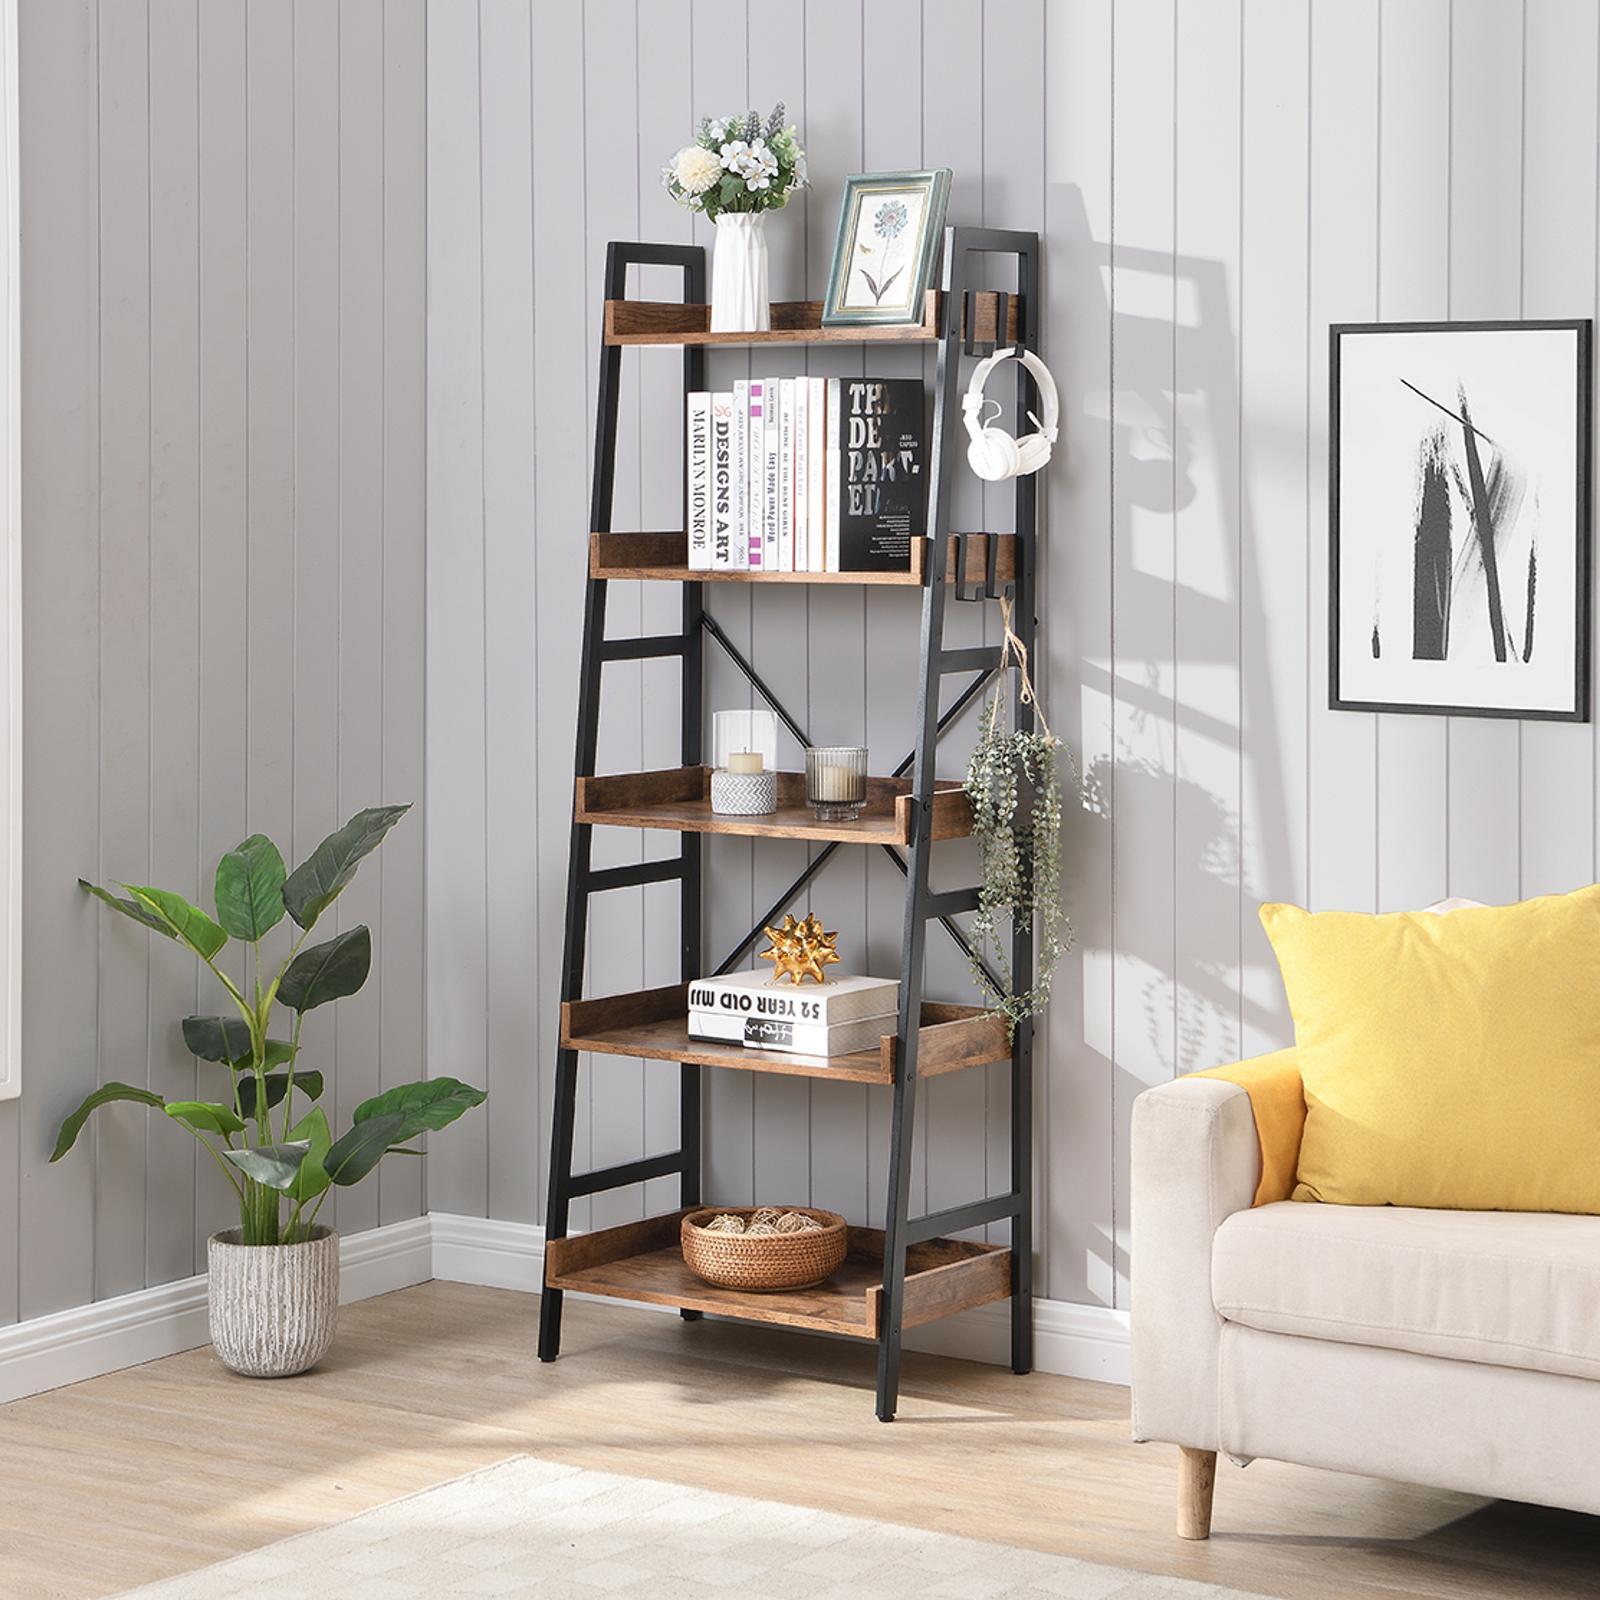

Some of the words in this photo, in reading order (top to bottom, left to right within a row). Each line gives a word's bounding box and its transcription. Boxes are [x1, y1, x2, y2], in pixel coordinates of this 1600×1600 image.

[693, 410, 706, 480] MARILYN
[716, 421, 730, 514] DESIGNS
[766, 452, 777, 470] Easy
[693, 484, 706, 550] MONROE
[716, 518, 730, 563] ART
[690, 988, 715, 1008] MJJ
[720, 992, 752, 1012] OLD
[757, 995, 797, 1017] YEAR
[800, 1001, 820, 1020] 52
